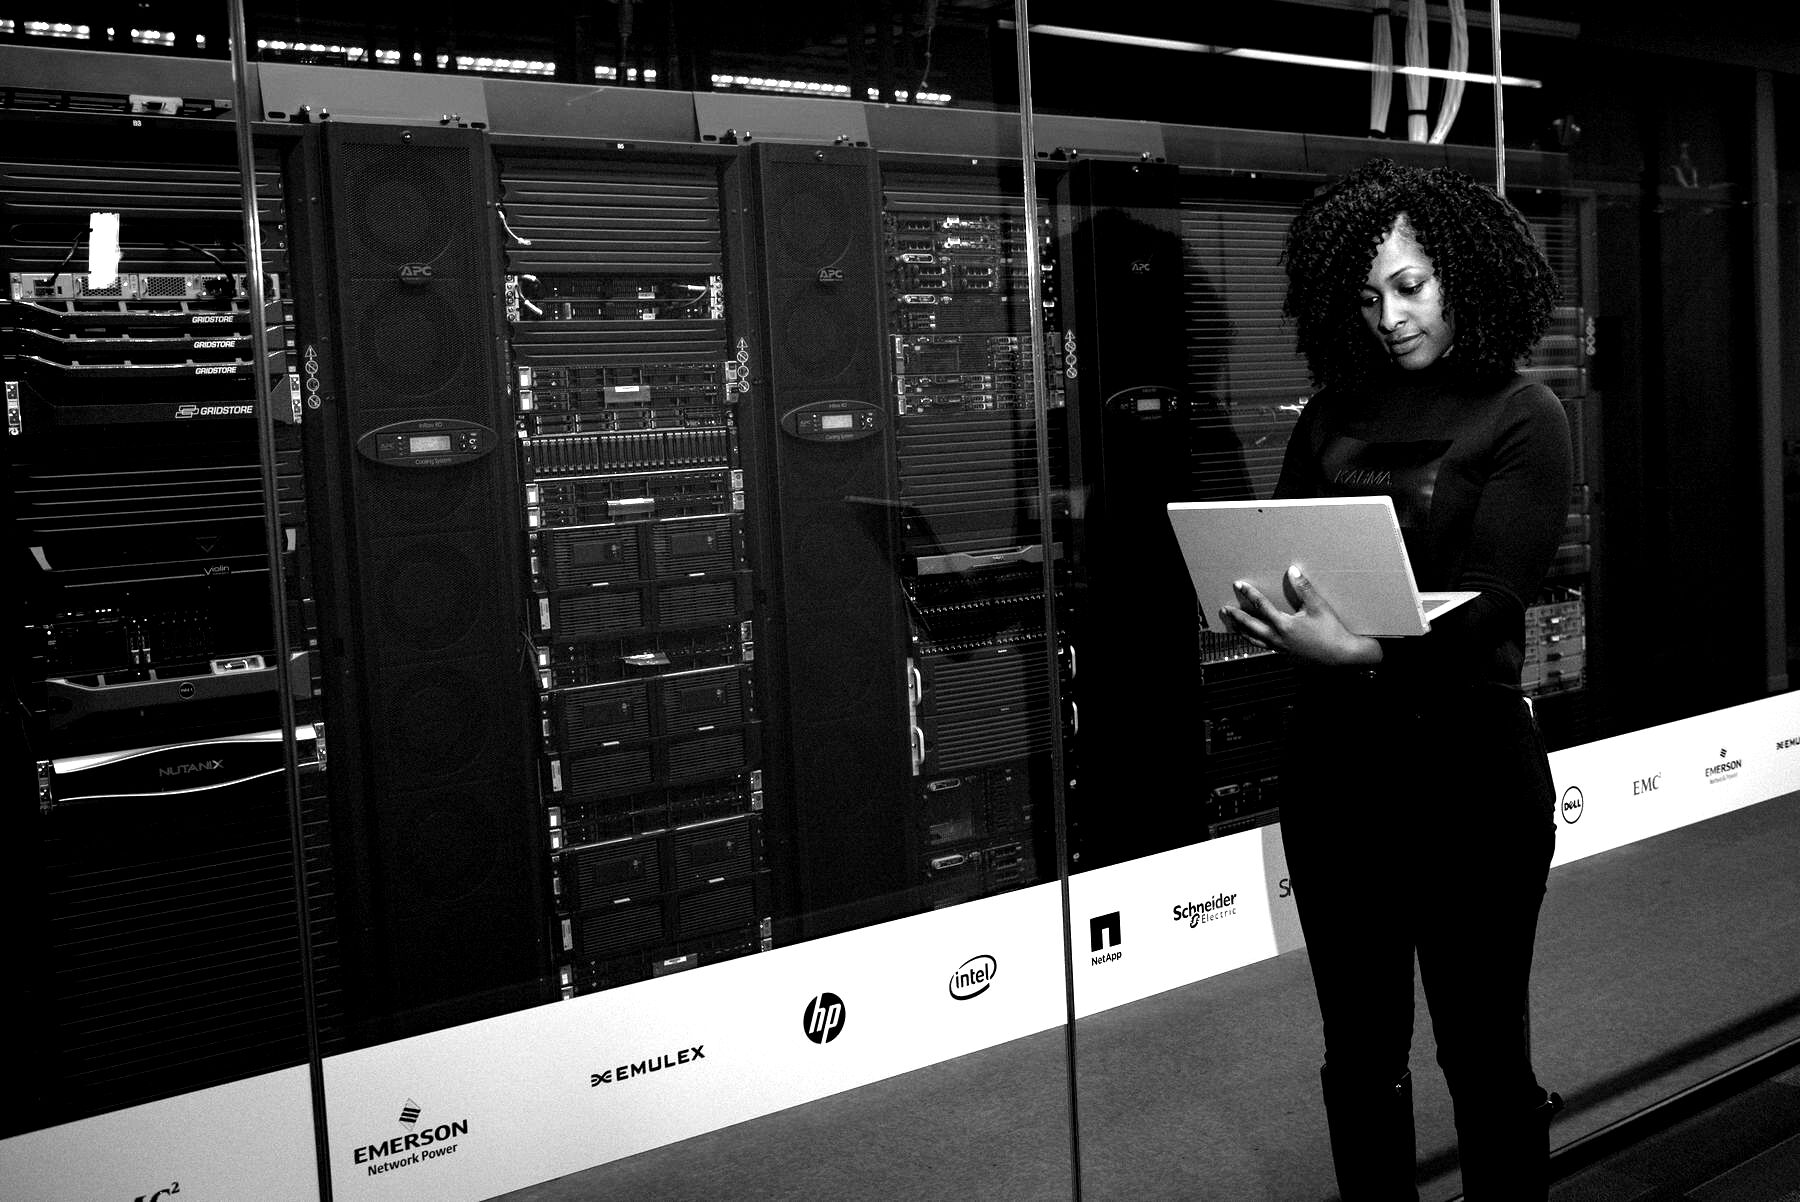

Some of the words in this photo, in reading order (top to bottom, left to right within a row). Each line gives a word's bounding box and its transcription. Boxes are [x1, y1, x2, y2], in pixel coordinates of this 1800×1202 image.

[401, 266, 432, 276] APC
[819, 269, 844, 279] APC
[1131, 263, 1151, 271] APC
[192, 315, 234, 324] GRIDSTORE
[193, 340, 236, 349] GRIDSTORE
[195, 366, 237, 375] GRIDSTORE
[200, 405, 253, 415] GRIDSTORE
[159, 759, 224, 777] NUTANIX
[1705, 758, 1742, 777] EMERSON
[1563, 798, 1581, 812] DELL
[1172, 892, 1237, 921] Schneider
[1201, 907, 1236, 924] Electric
[1091, 951, 1122, 966] NetApp
[955, 963, 989, 989] intel
[807, 994, 842, 1045] hp
[616, 1045, 705, 1082] EMULEX
[354, 1119, 468, 1164] EMERSON
[368, 1153, 419, 1176] Network
[422, 1143, 458, 1161] Power
